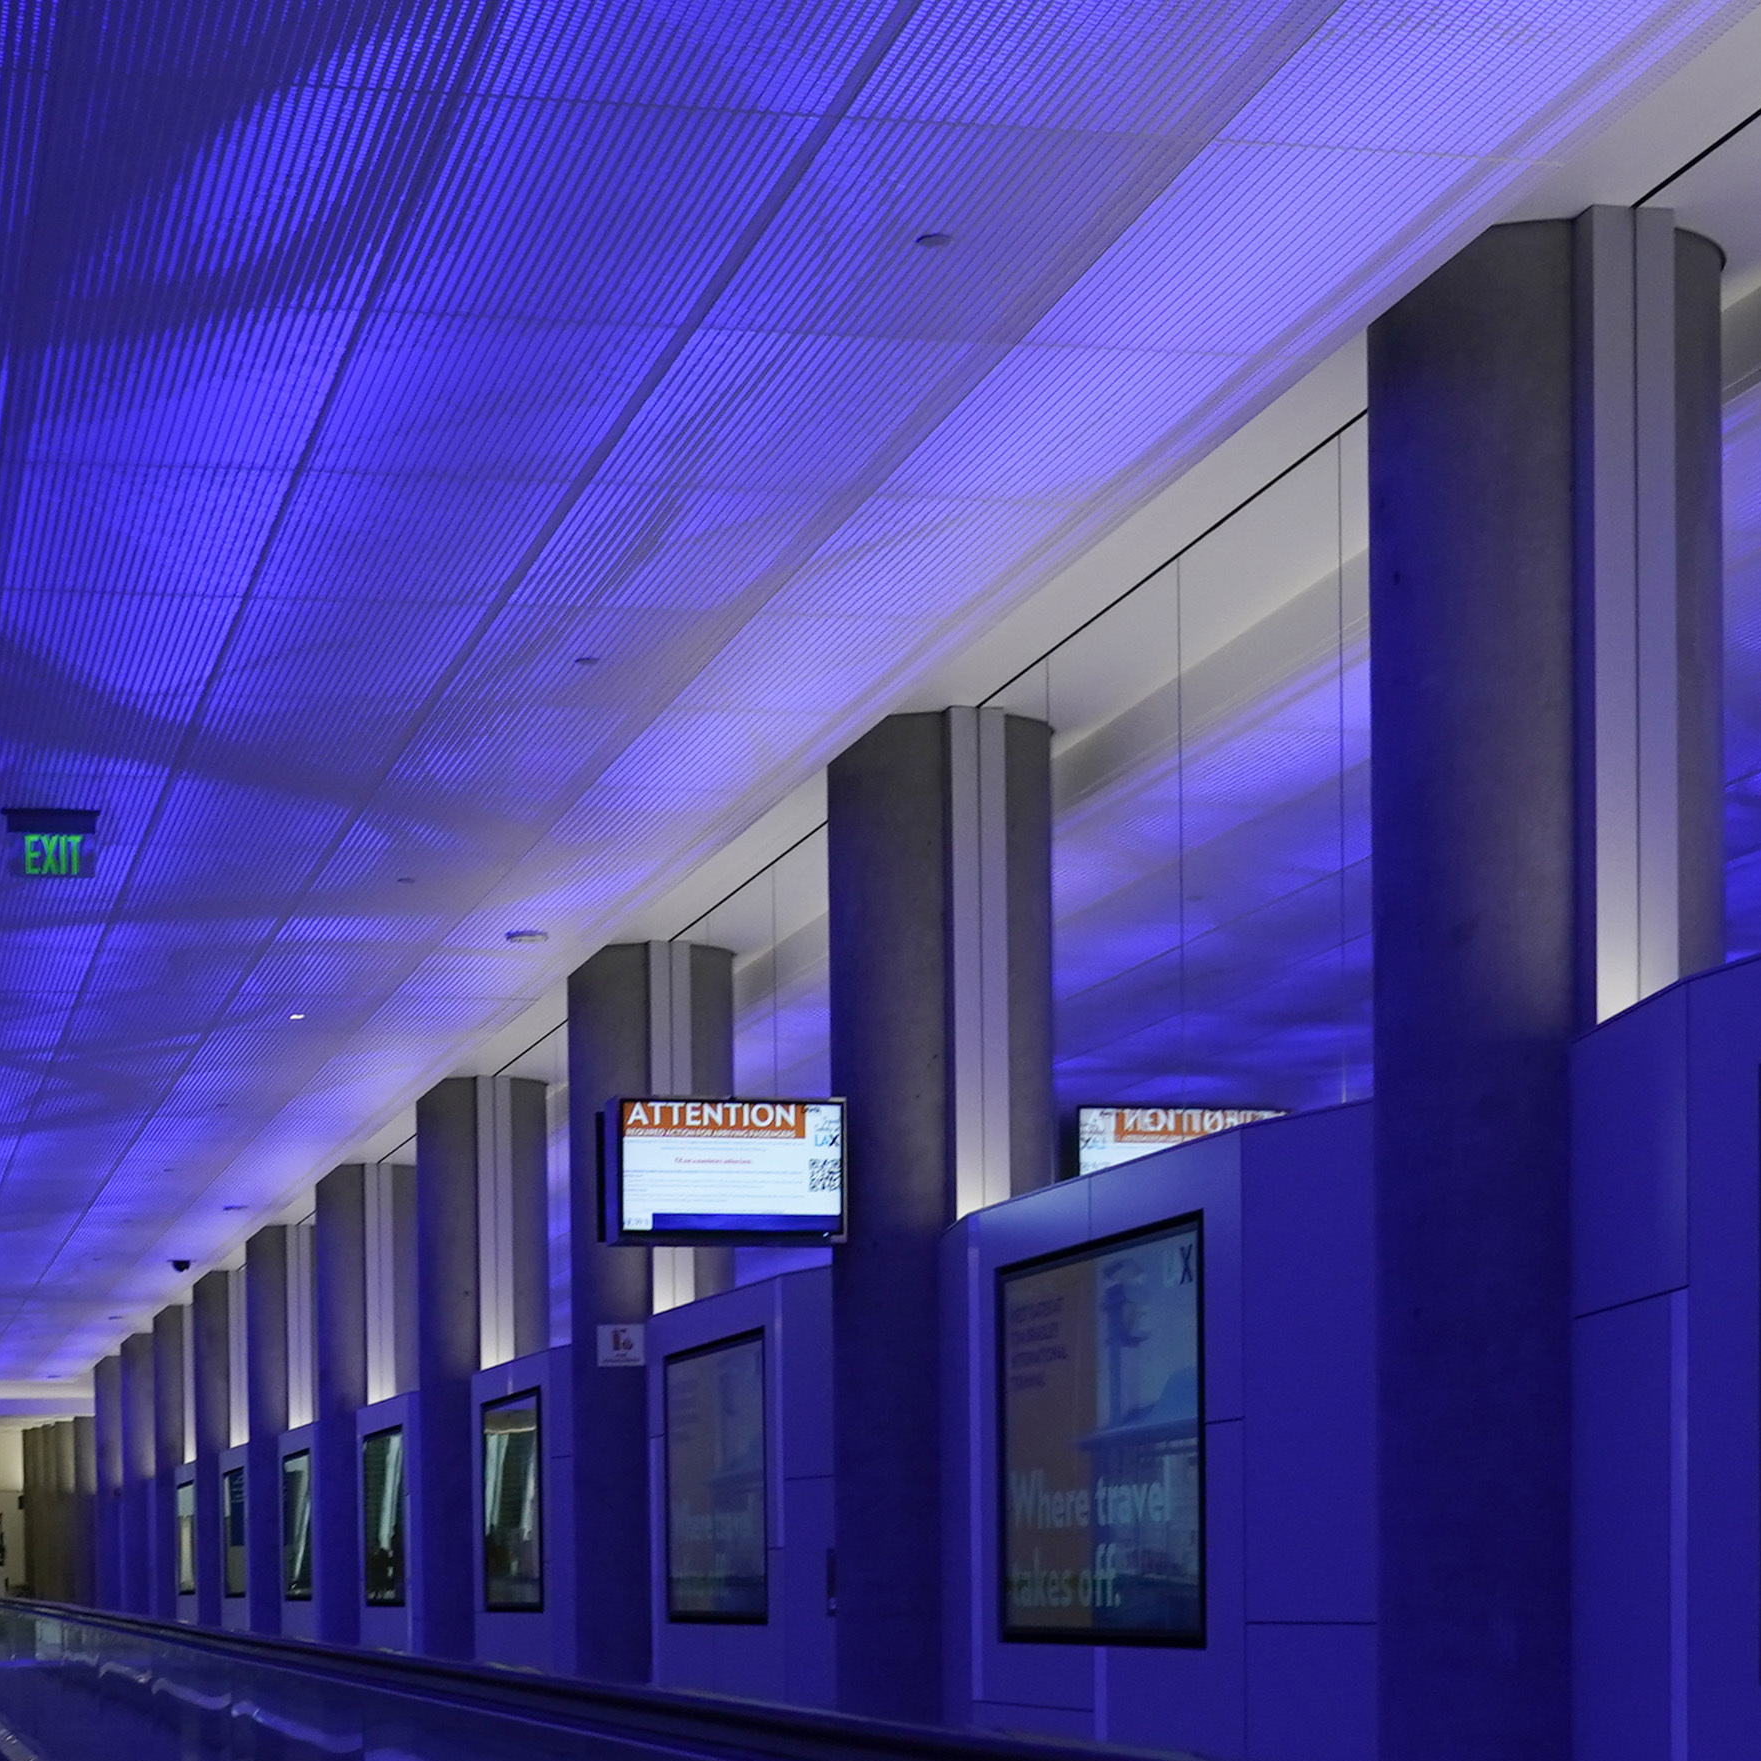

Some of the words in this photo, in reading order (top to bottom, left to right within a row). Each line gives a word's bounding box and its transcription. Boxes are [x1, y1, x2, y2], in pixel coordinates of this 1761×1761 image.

[24, 833, 83, 875] EXIT
[626, 1101, 796, 1127] ATTENTION
[1010, 1468, 1090, 1529] Where
[1094, 1459, 1172, 1526] travel
[1011, 1546, 1073, 1608] takes
[1078, 1543, 1122, 1608] off.
